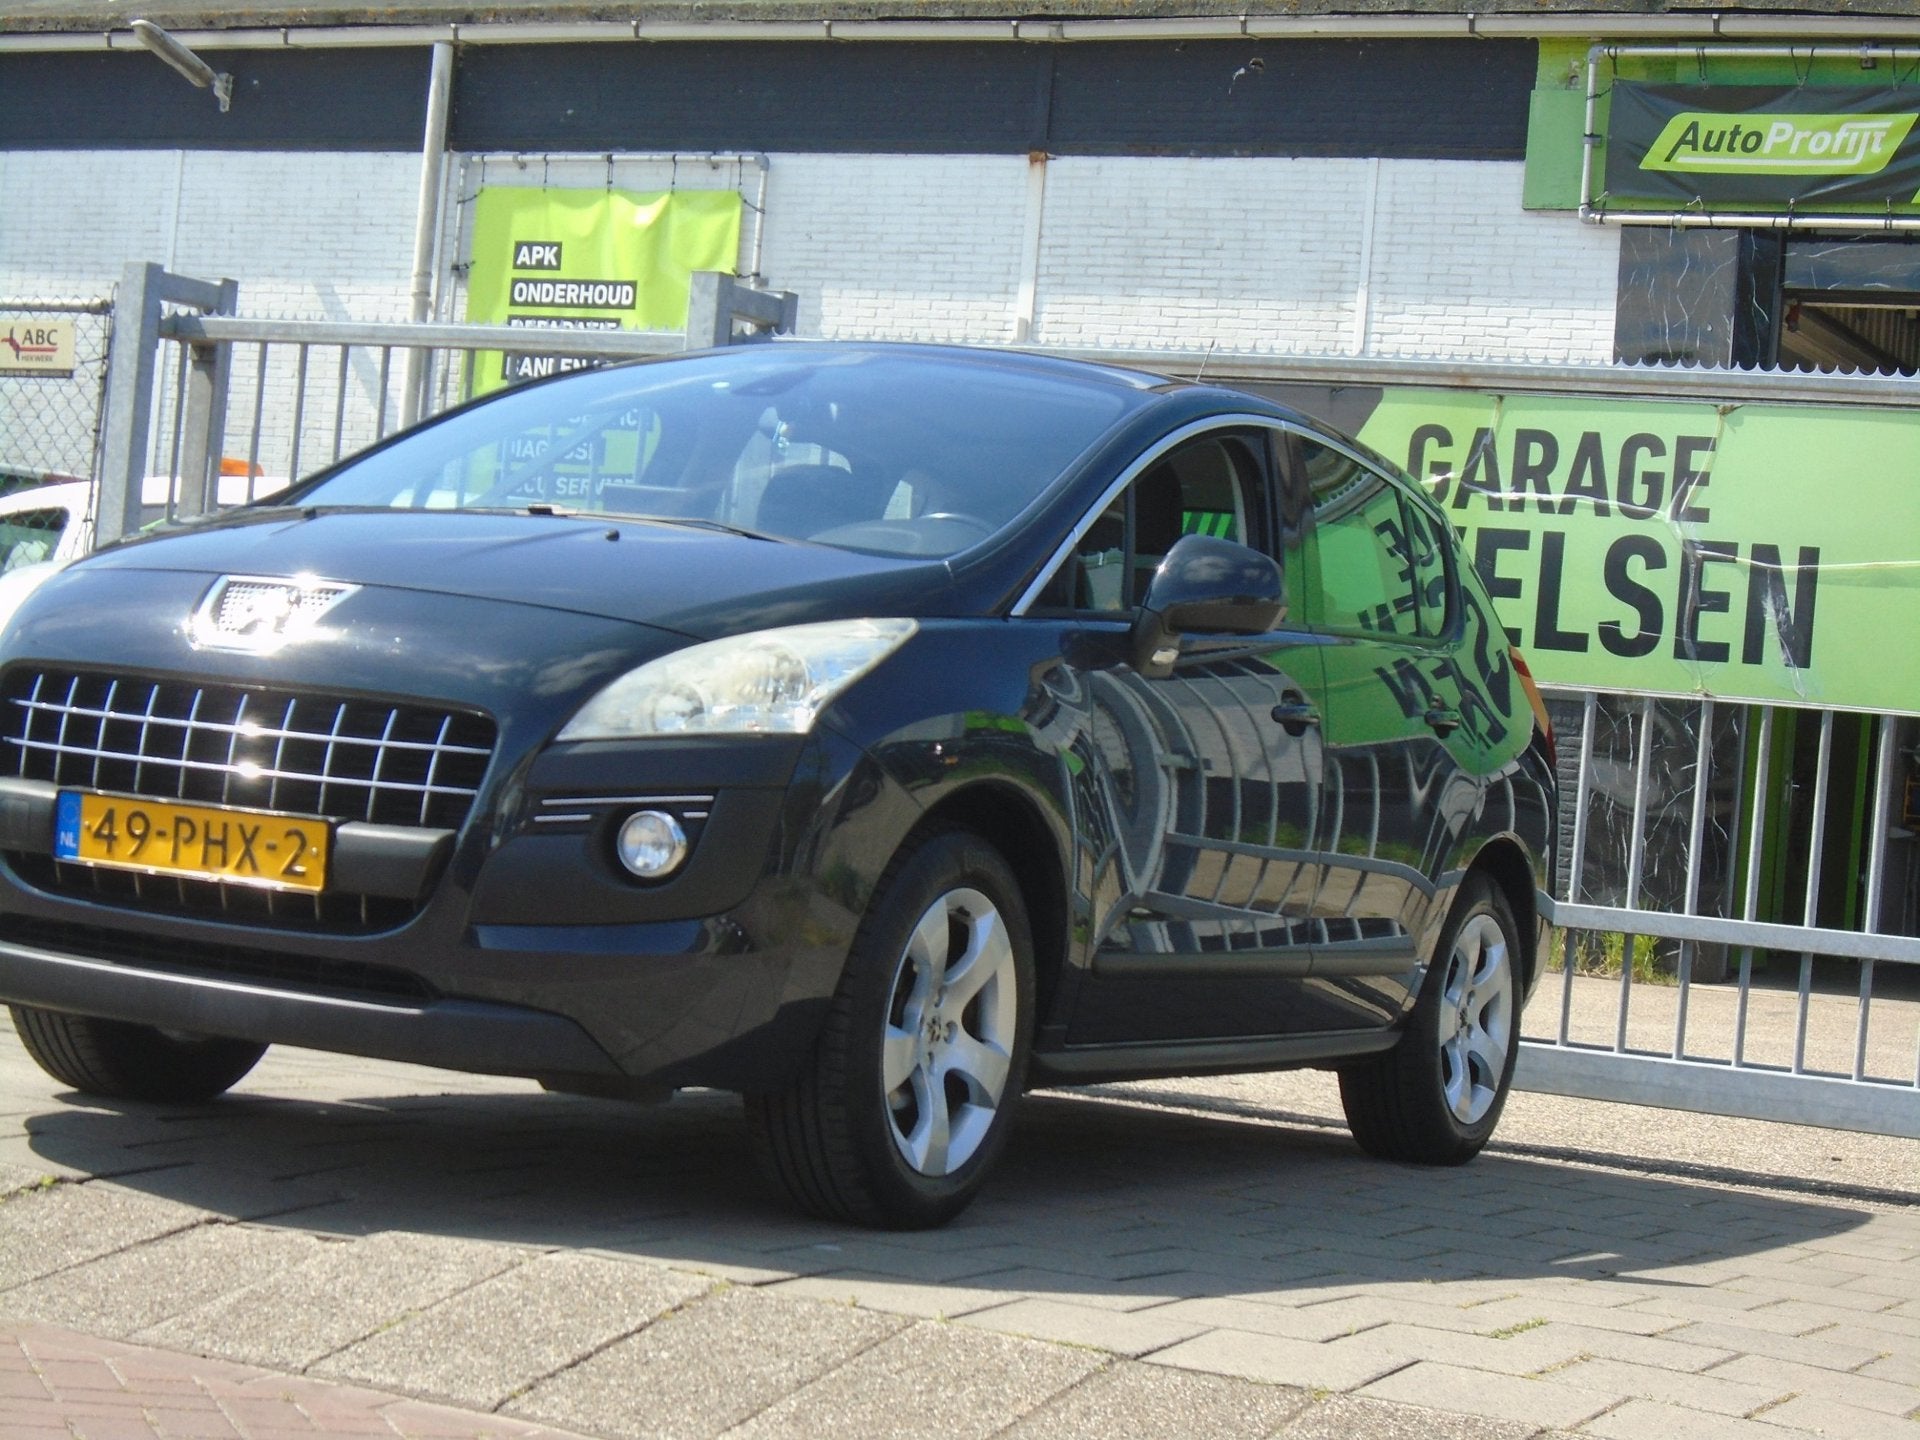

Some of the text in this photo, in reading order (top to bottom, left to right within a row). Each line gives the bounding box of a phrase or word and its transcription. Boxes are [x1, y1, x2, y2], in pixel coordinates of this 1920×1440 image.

[1664, 120, 1893, 166] AutoProfijt
[515, 245, 558, 267] APK
[513, 281, 634, 306] ONDERHOUD
[22, 328, 58, 346] ABC
[1407, 422, 1717, 523] GARAGE
[1455, 525, 1820, 668] ELSEN
[60, 831, 77, 849] NL
[92, 808, 308, 877] 49-PHX-2
